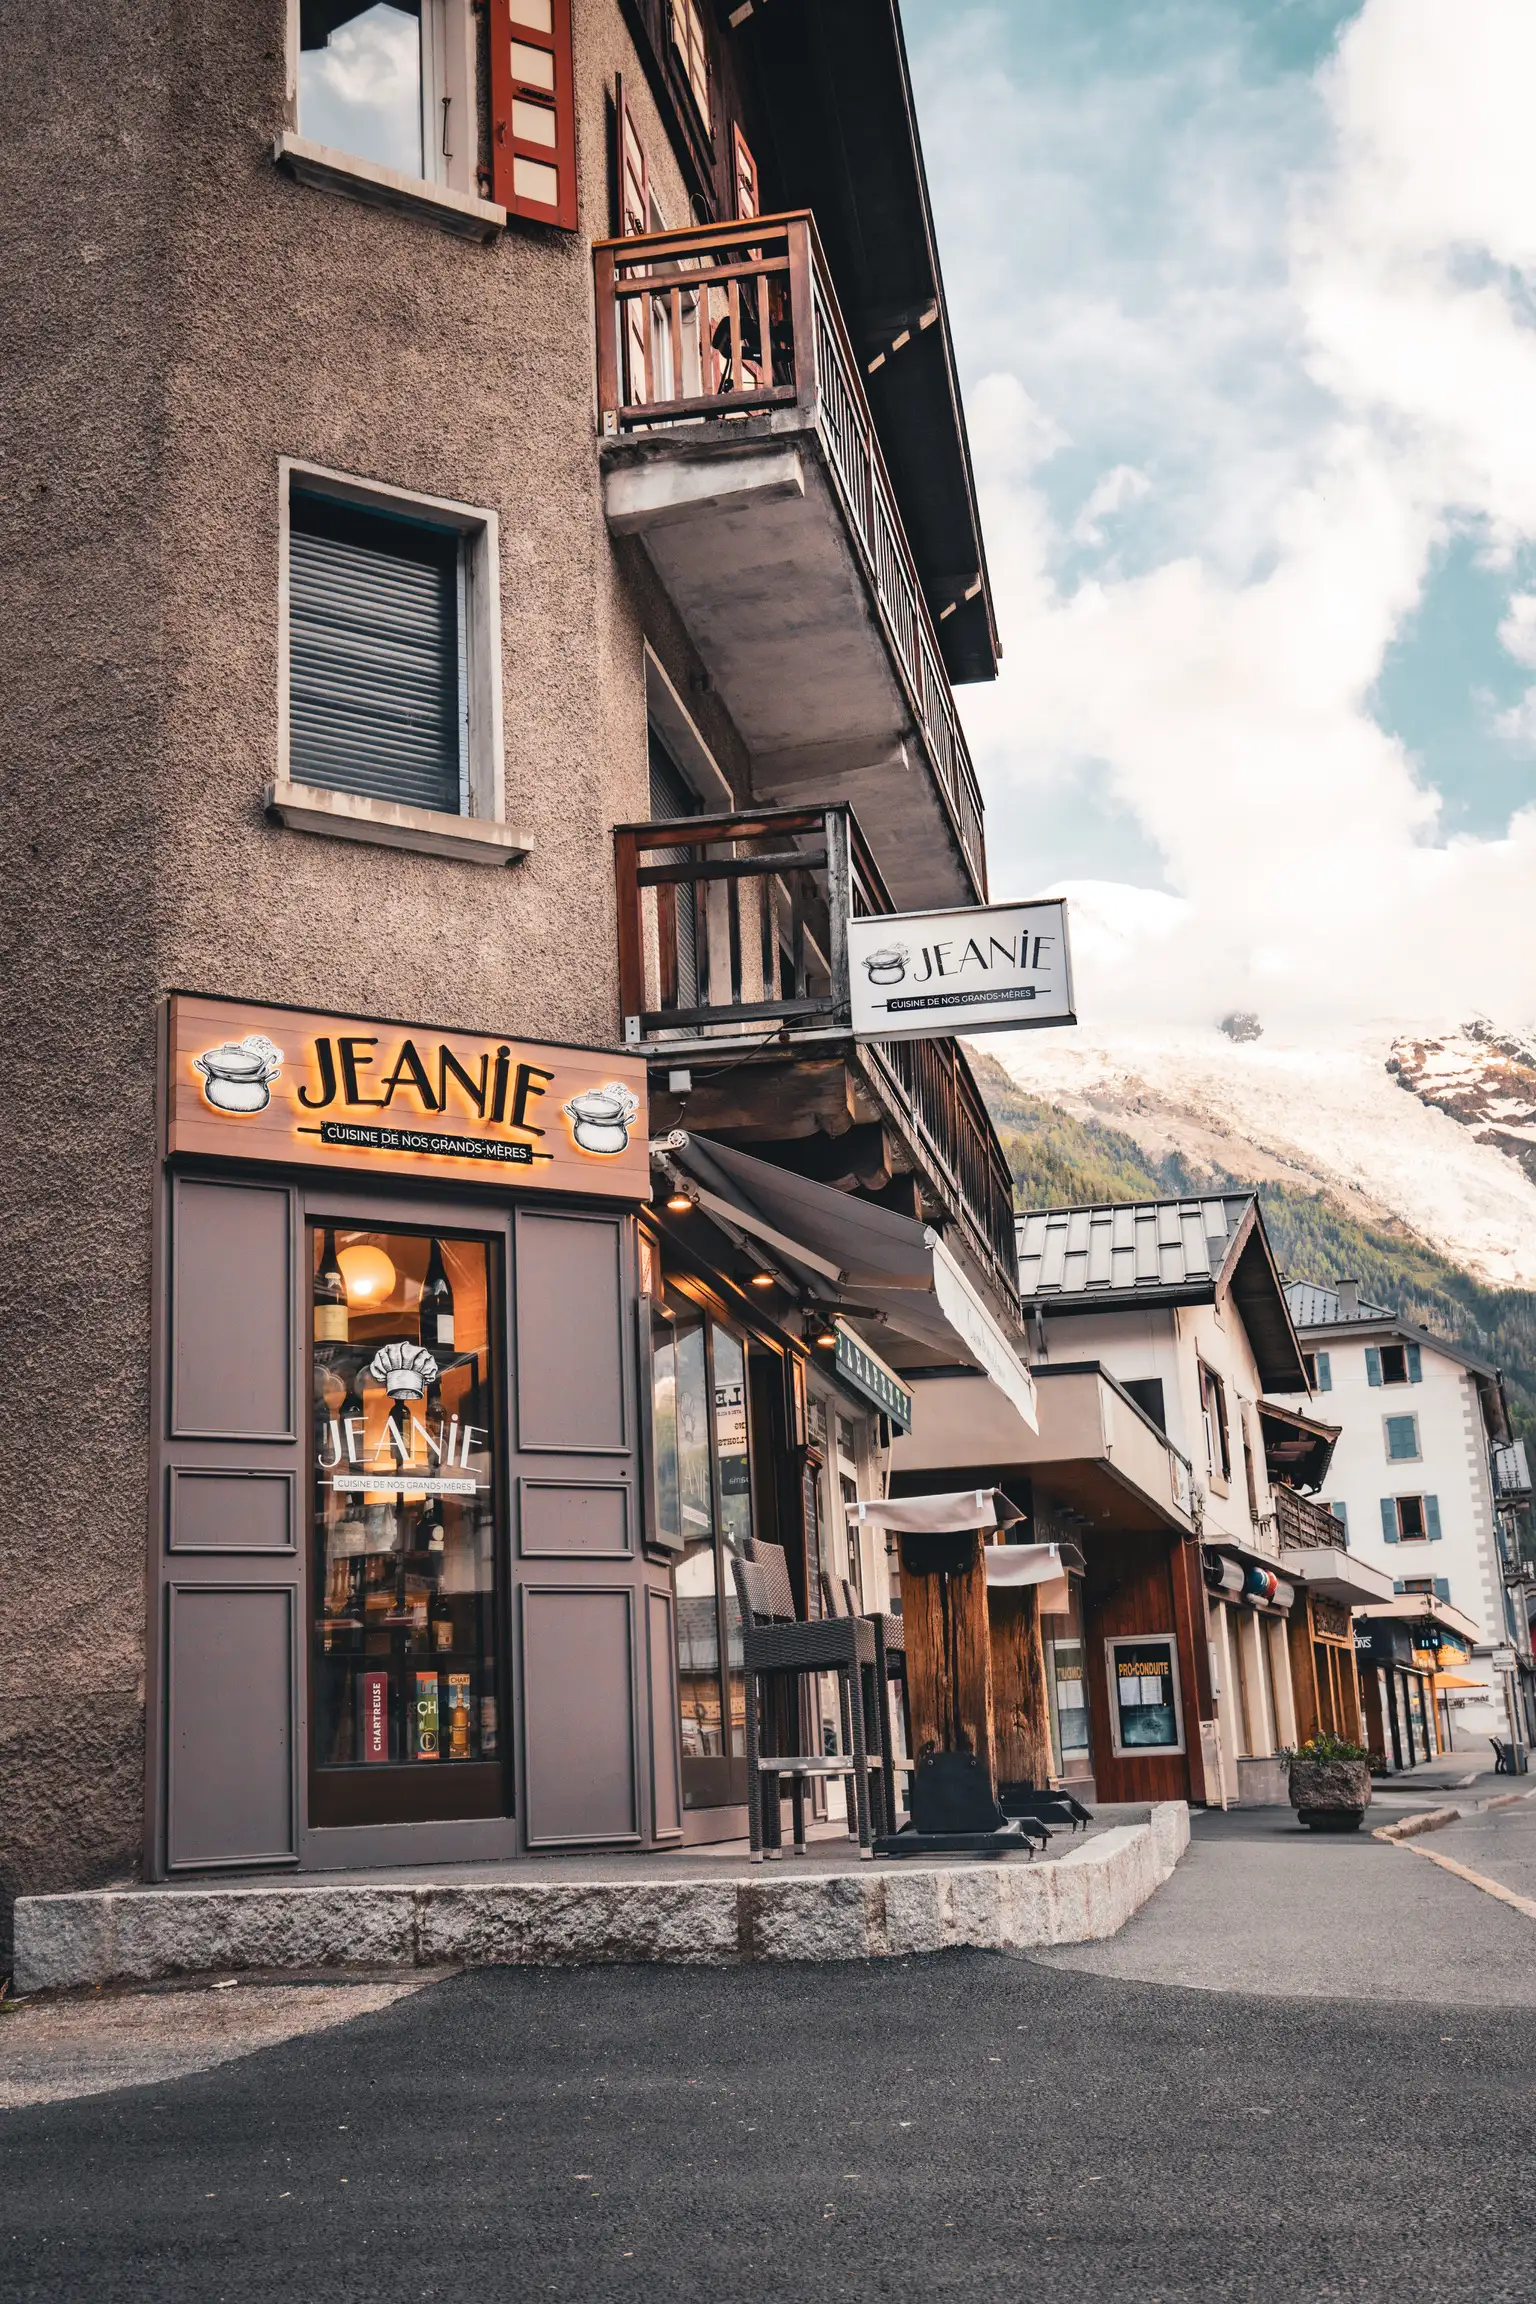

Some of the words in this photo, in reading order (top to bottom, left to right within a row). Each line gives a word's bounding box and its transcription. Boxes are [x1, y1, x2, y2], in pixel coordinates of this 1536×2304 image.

[891, 999, 926, 1009] CUISINE
[927, 998, 940, 1006] DE
[941, 996, 960, 1005] NOS
[961, 989, 1031, 1003] GRANDS-MÈRES
[327, 1126, 379, 1144] CUISINE
[381, 1132, 399, 1145] DE
[402, 1135, 429, 1149] NOS
[430, 1138, 527, 1160] GRANDS-MÈRES
[337, 1479, 371, 1488] CUISINE
[373, 1480, 385, 1489] DE
[387, 1481, 405, 1489] NOS
[1118, 1661, 1169, 1677] PRO-CONDUITE
[372, 1682, 382, 1751] CHARTREUSE
